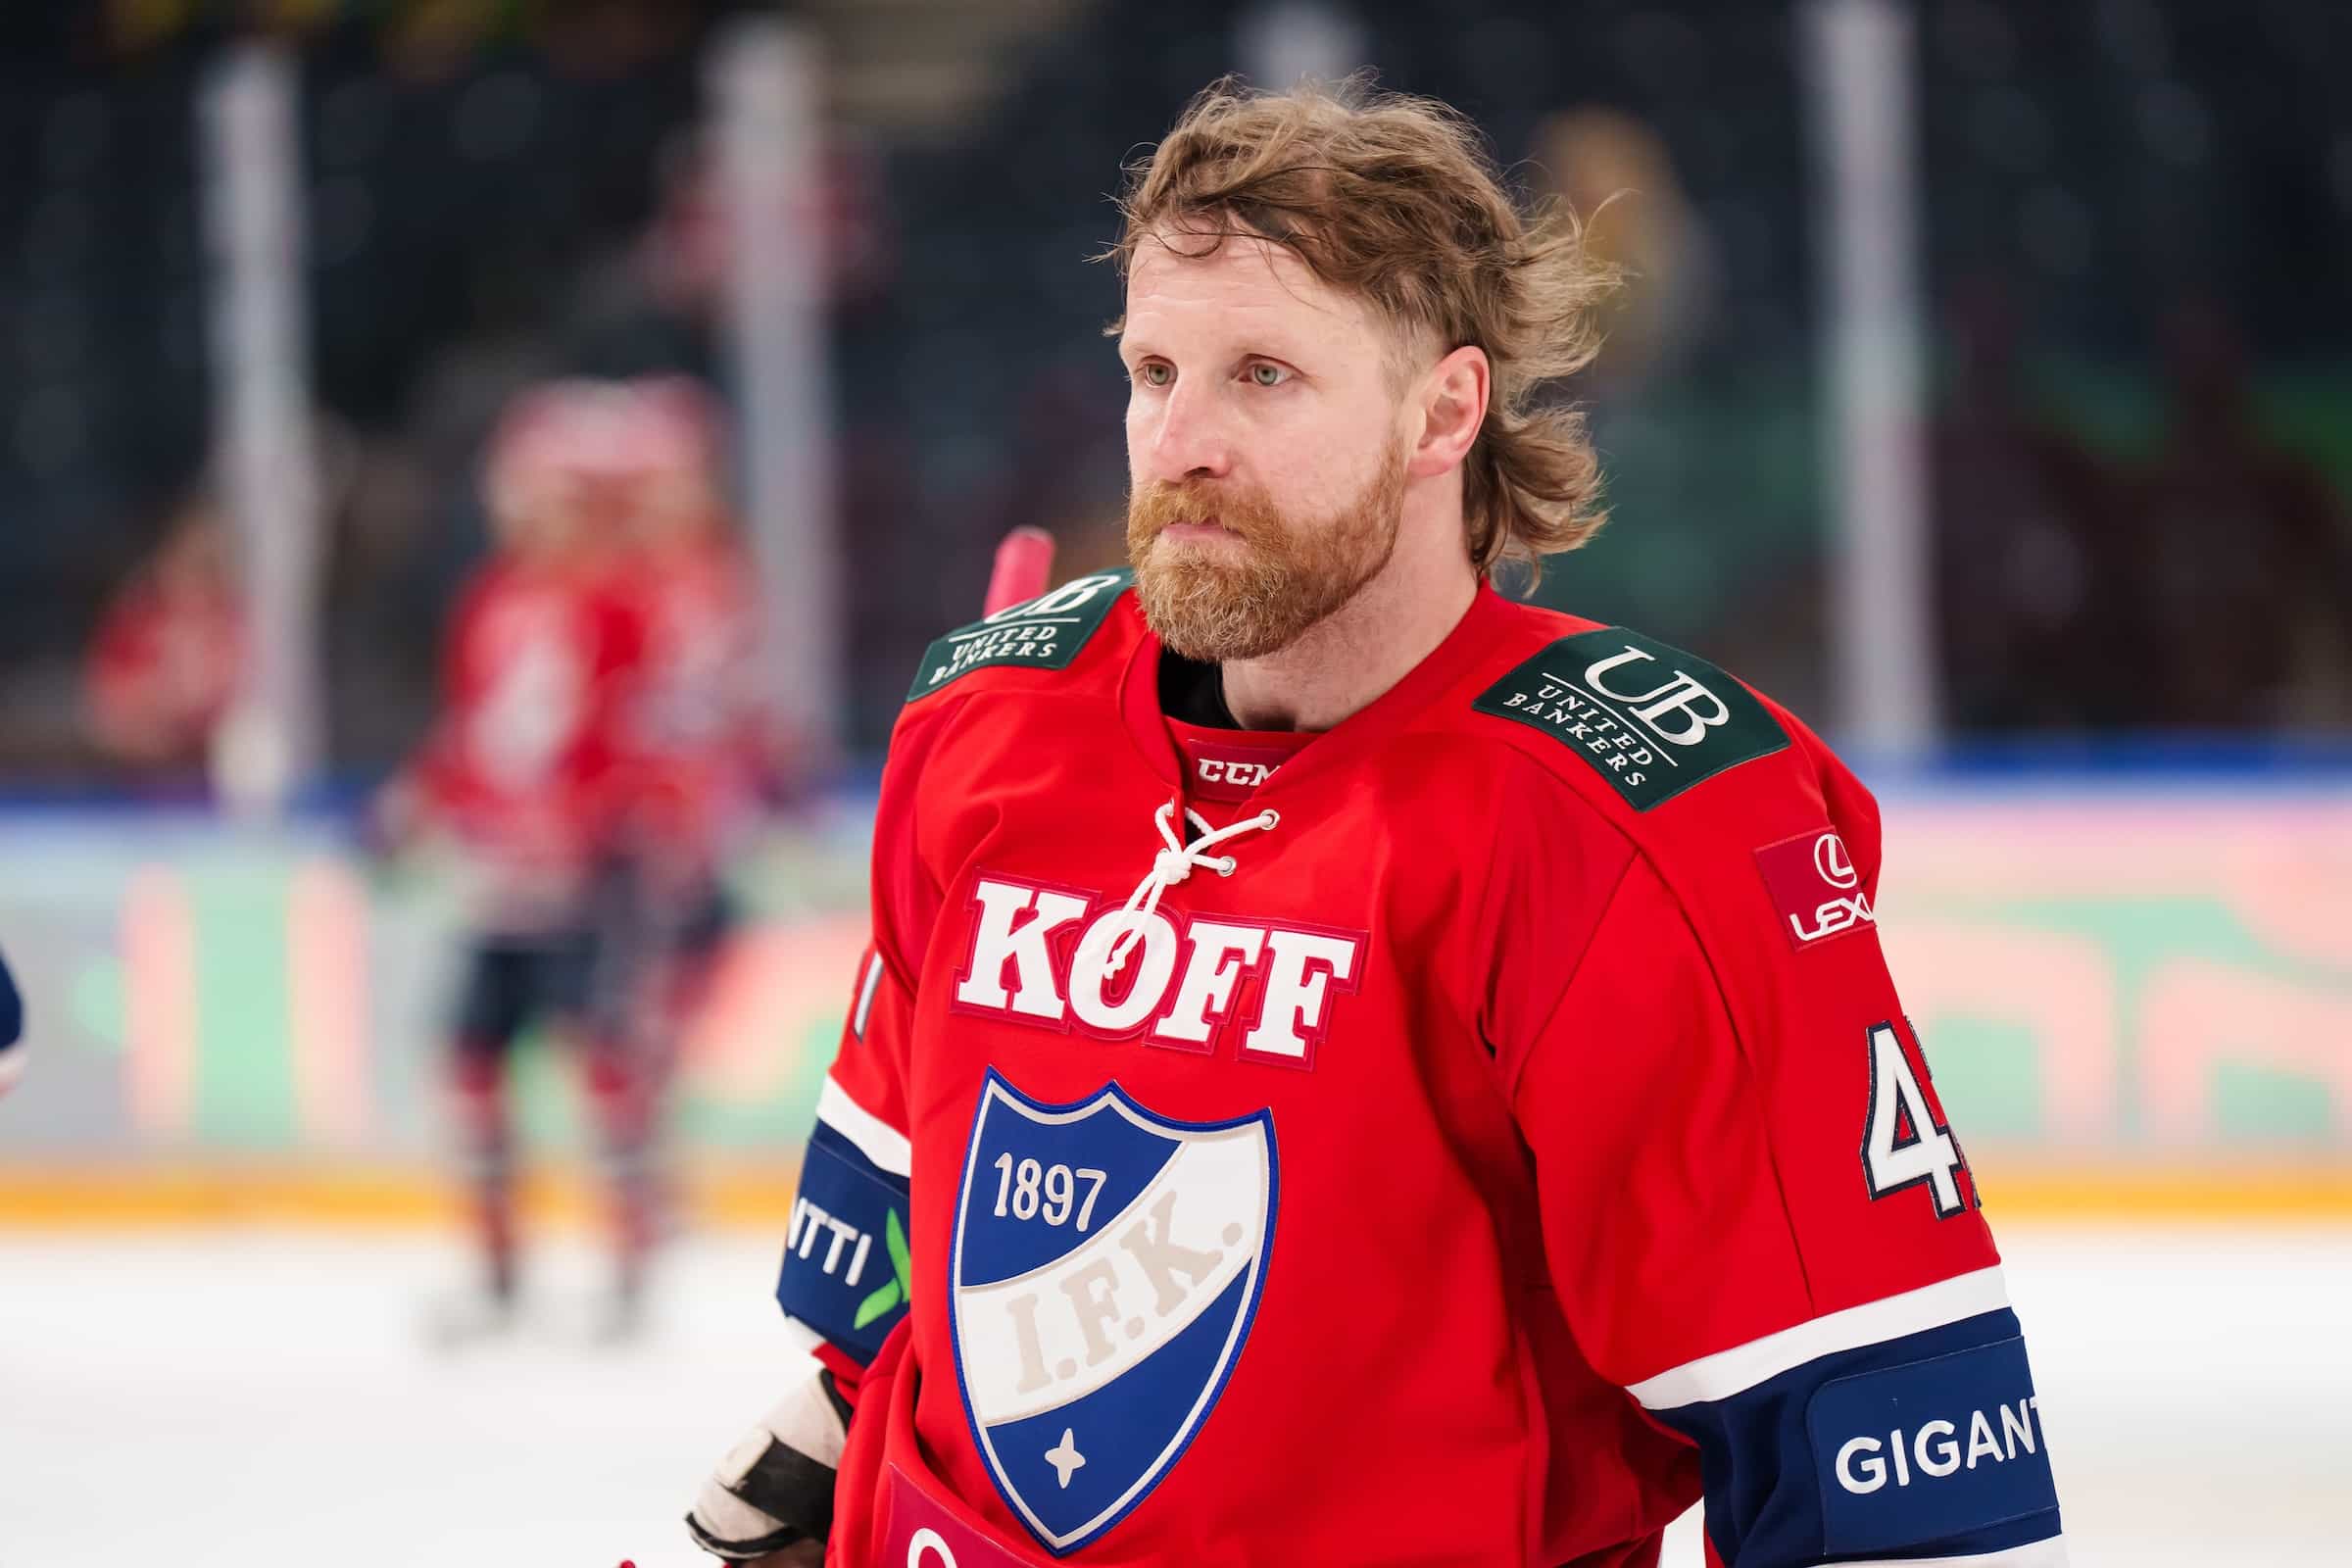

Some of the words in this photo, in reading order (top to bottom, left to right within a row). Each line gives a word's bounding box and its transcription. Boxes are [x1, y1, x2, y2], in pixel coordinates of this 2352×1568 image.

[928, 643, 1057, 685] BANKERS
[952, 626, 1057, 662] UNITED
[1538, 685, 1652, 765] UNITED
[1585, 645, 1730, 745] UB
[1503, 692, 1646, 786] BANKERS
[1789, 893, 1874, 941] LEX
[956, 881, 1355, 1057] KOFF
[1860, 1017, 1981, 1221] 4
[994, 1152, 1107, 1232] 1897
[1005, 1189, 1244, 1396] I.F.K.
